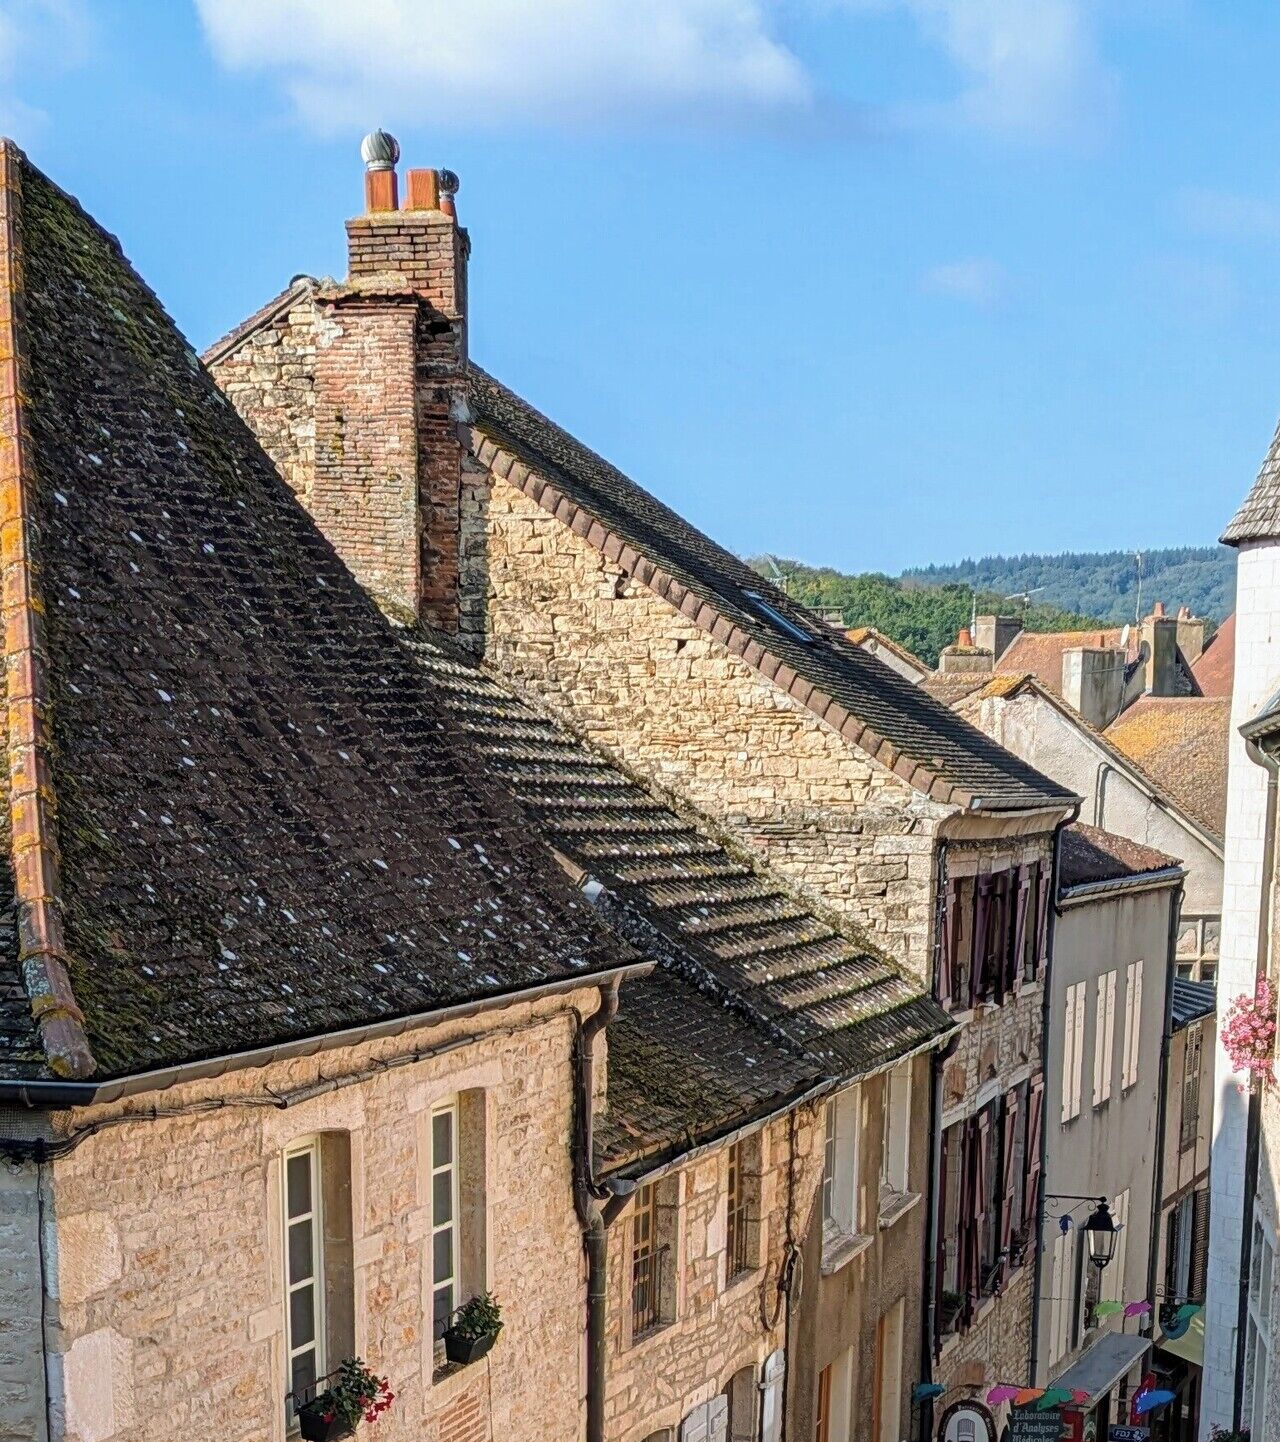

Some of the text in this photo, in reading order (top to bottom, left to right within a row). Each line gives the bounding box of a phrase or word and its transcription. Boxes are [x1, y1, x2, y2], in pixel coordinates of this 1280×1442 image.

[1013, 1409, 1061, 1420] Laboratoire
[1013, 1422, 1060, 1435] d'Analyses
[1115, 1430, 1130, 1438] FDJ
